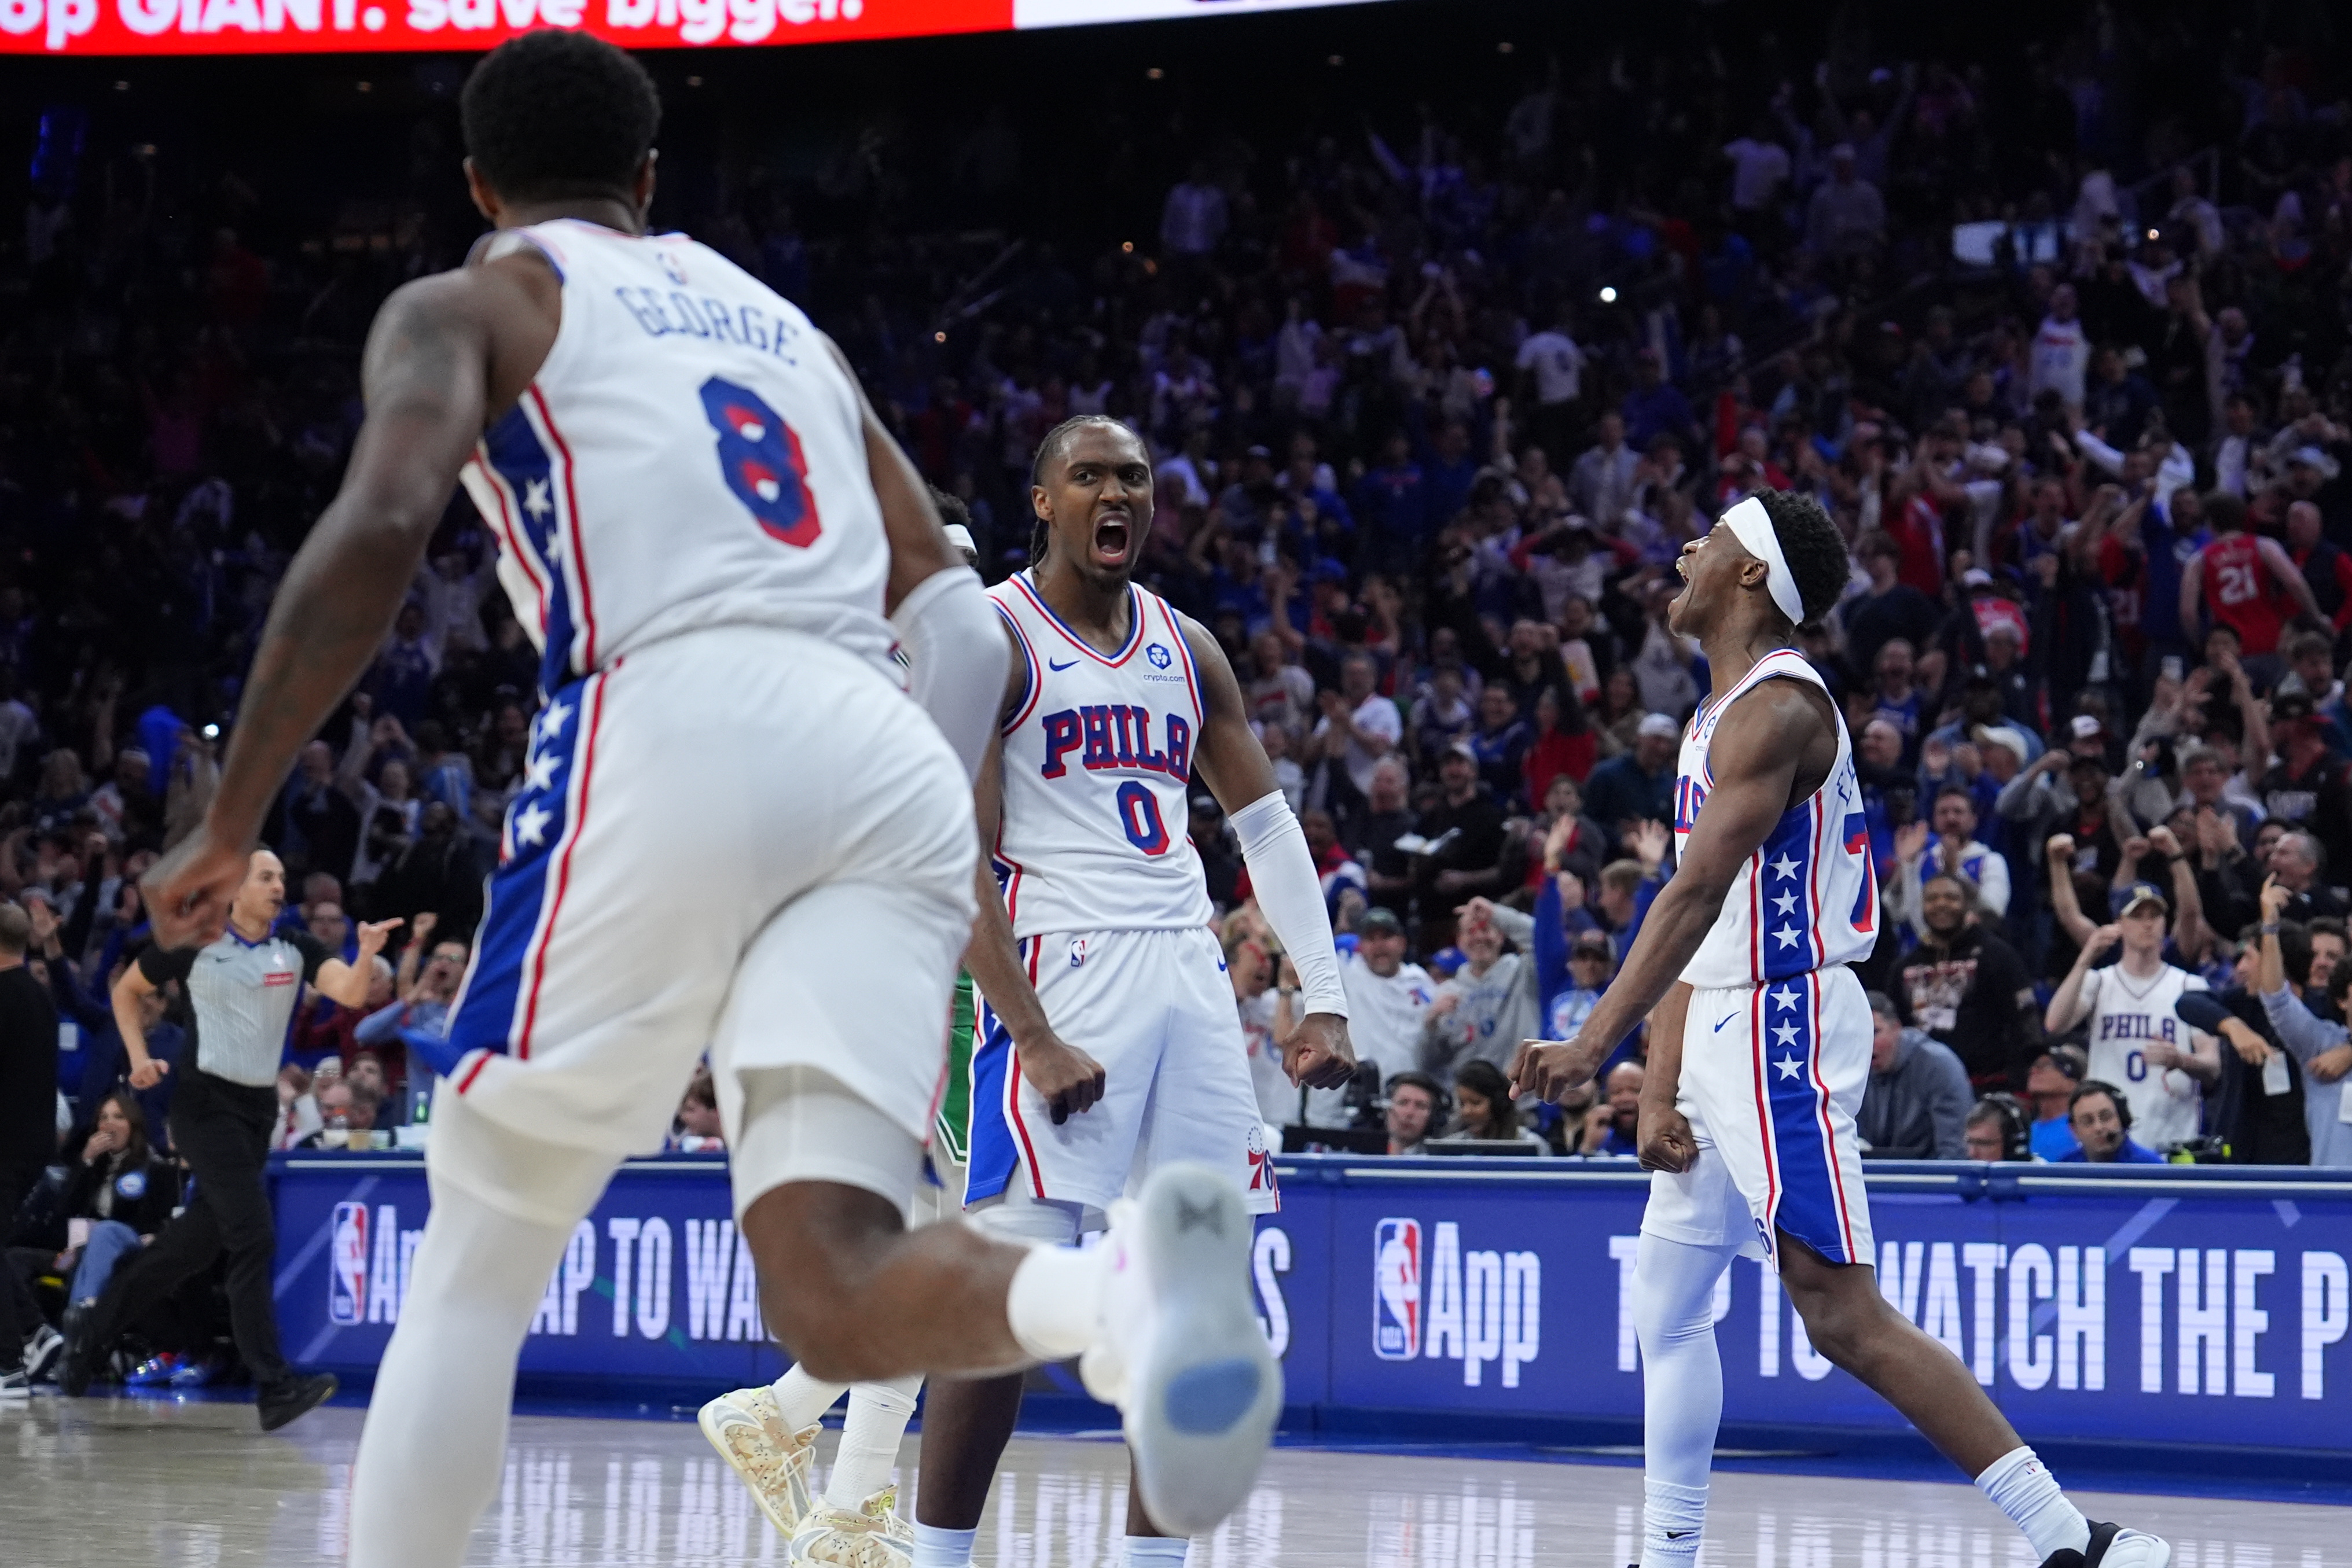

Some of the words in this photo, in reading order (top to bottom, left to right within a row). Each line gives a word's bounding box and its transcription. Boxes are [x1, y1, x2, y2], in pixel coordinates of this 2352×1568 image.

[615, 287, 798, 366] GEORGE
[699, 375, 823, 549] 8
[2217, 563, 2259, 605] 21
[1143, 674, 1185, 683] crypto.com
[1042, 705, 1190, 785] PHILA
[1116, 781, 1170, 856] 0
[1843, 812, 1874, 933] 7
[2101, 1014, 2177, 1044] PHILA
[2127, 1051, 2147, 1083] 0
[1248, 1148, 1273, 1191] 76
[608, 1216, 672, 1340] TO
[685, 1218, 781, 1343] WA
[1425, 1221, 1541, 1388] App
[2129, 1247, 2275, 1398] THE
[2301, 1250, 2349, 1400] P
